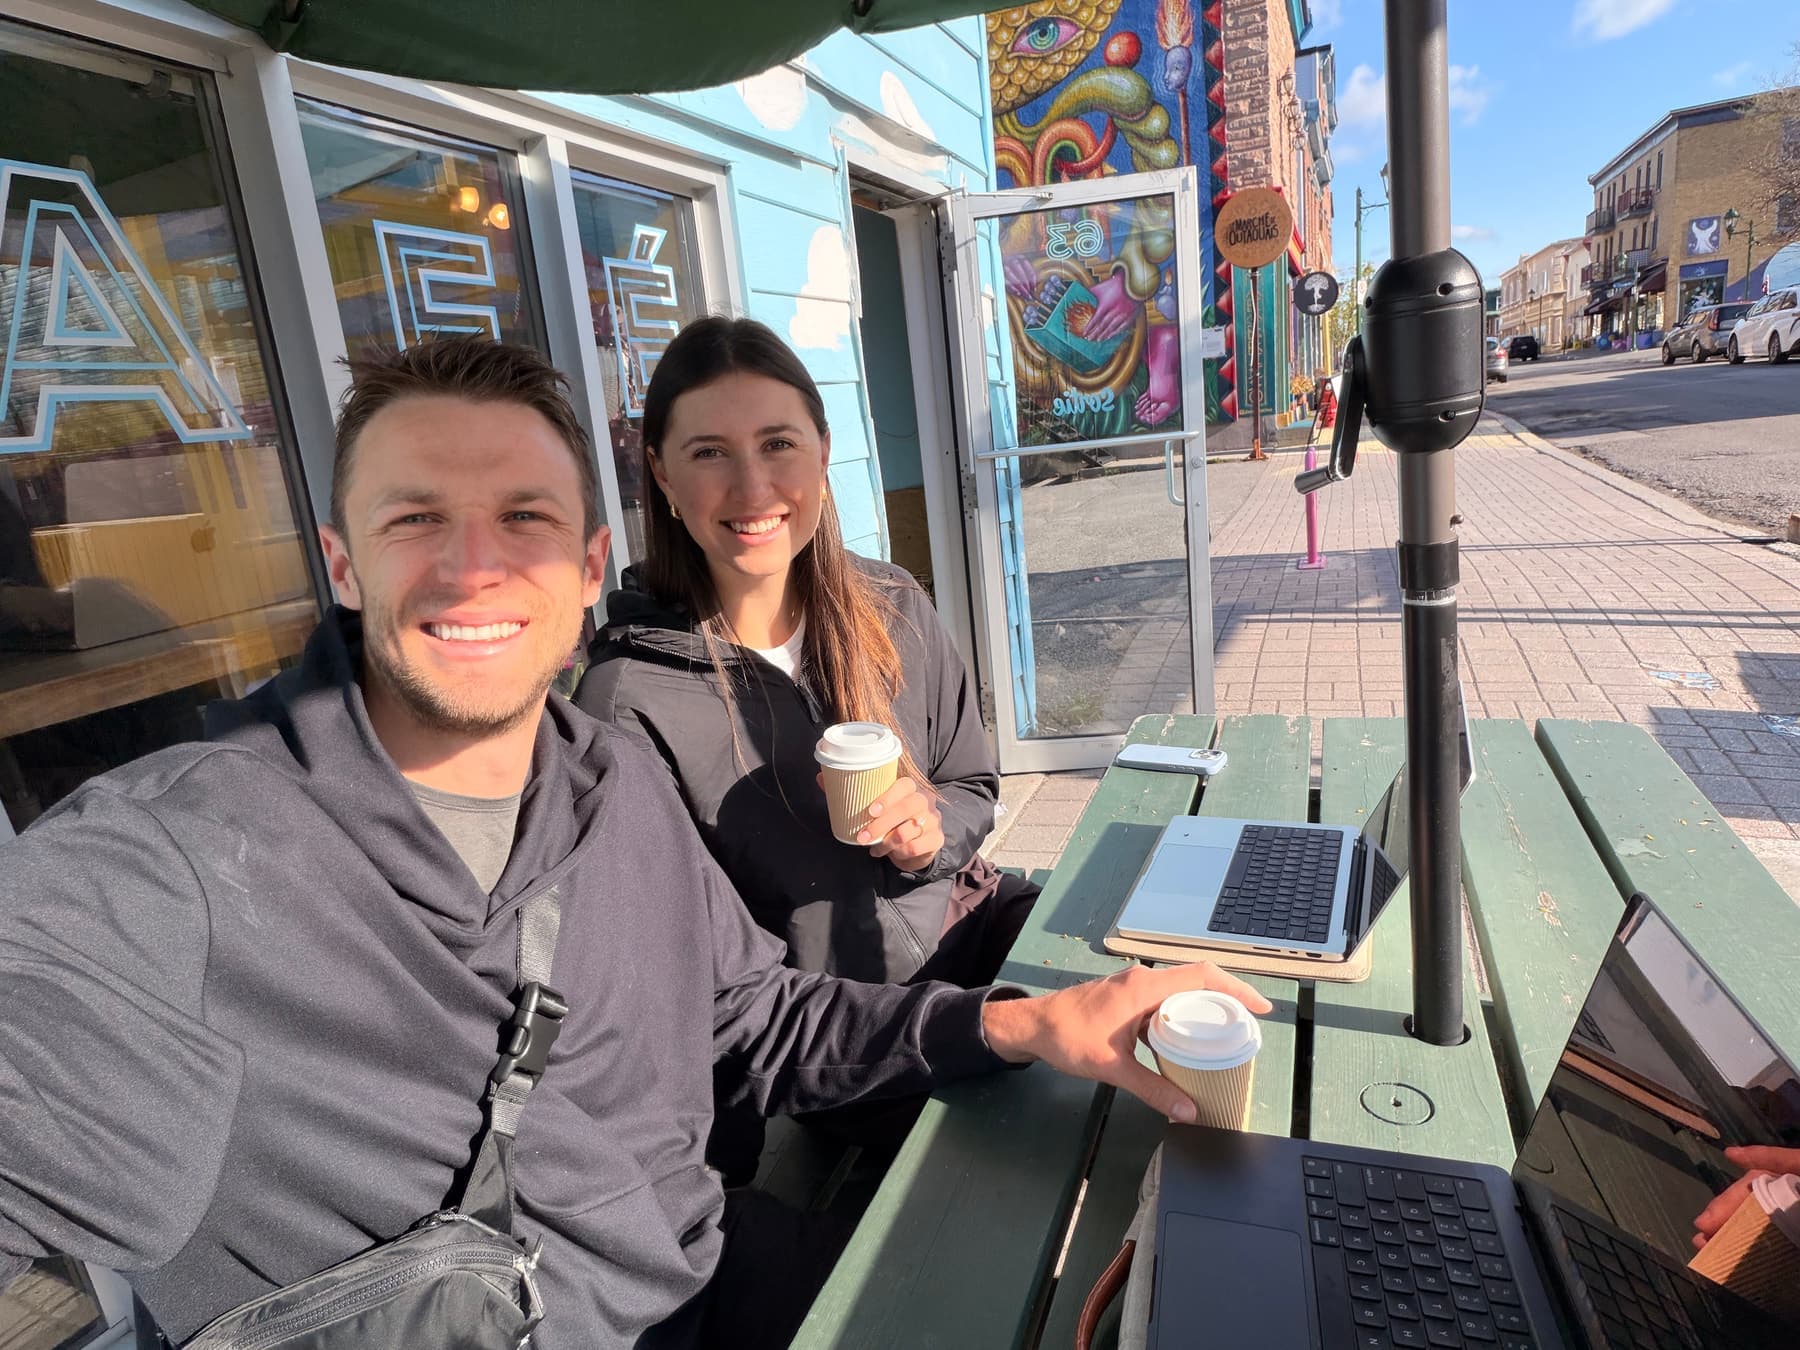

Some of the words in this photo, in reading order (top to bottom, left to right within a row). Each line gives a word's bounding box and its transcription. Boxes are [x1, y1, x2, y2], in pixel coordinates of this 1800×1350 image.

[1465, 1321, 1476, 1329] 6
[1402, 1330, 1413, 1338] H
[1368, 1337, 1379, 1345] N
